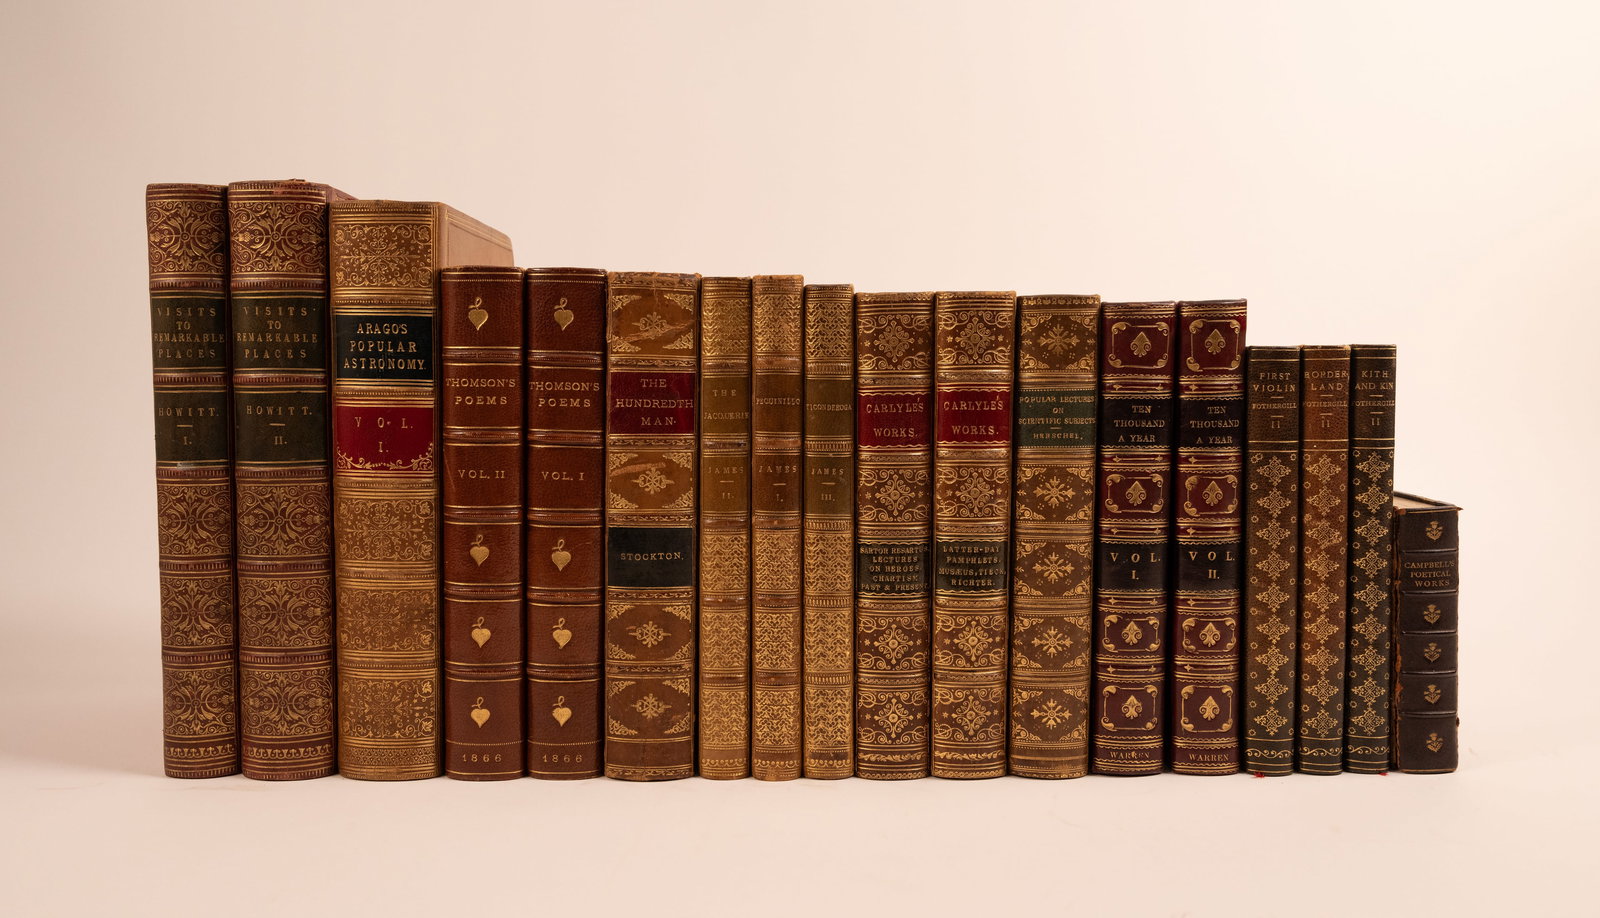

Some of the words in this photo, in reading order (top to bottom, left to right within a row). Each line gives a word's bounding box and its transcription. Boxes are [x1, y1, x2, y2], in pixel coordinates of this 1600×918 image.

[156, 307, 216, 317] VISITS
[176, 321, 191, 331] TO
[267, 320, 281, 330] TO
[154, 332, 225, 343] REMARKABLE
[236, 332, 318, 343] REMARKABLE
[350, 340, 417, 353] POPULAR
[158, 349, 216, 358] PLACES
[244, 349, 306, 359] PLACES
[343, 357, 426, 370] ASTRONOMY.
[445, 378, 516, 387] THOMSON'S
[529, 382, 600, 391] THOMSON'S
[640, 378, 667, 388] THE
[455, 396, 507, 405] POEMS
[538, 399, 591, 407] POEMS
[615, 399, 694, 409] HUNDREDTH
[943, 395, 1004, 411] CARLYLE'S
[866, 397, 924, 414] CARLYLE'S
[1132, 405, 1152, 414] TEN
[1207, 406, 1226, 414] TEN
[246, 406, 313, 416] HOWITT.
[1113, 420, 1165, 428] THOUSAND
[1190, 420, 1240, 428] THOUSAND
[873, 428, 918, 438] WORKS.
[952, 425, 999, 435] WORKS.
[183, 436, 192, 445] I.
[274, 436, 288, 445] II.
[1130, 435, 1156, 443] YEAR
[1208, 436, 1233, 444] YEAR
[378, 441, 388, 453] I.
[458, 470, 490, 479] VOL.
[495, 470, 505, 479] II
[541, 472, 574, 481] VOL.
[579, 472, 584, 480] I
[821, 493, 835, 502] III.
[620, 552, 684, 561] STOCKTON.
[1404, 560, 1455, 568] CAMPBELL'S
[1131, 570, 1139, 580] I.
[1208, 569, 1220, 579] II.
[462, 754, 502, 763] 1866
[542, 754, 582, 763] 1866
